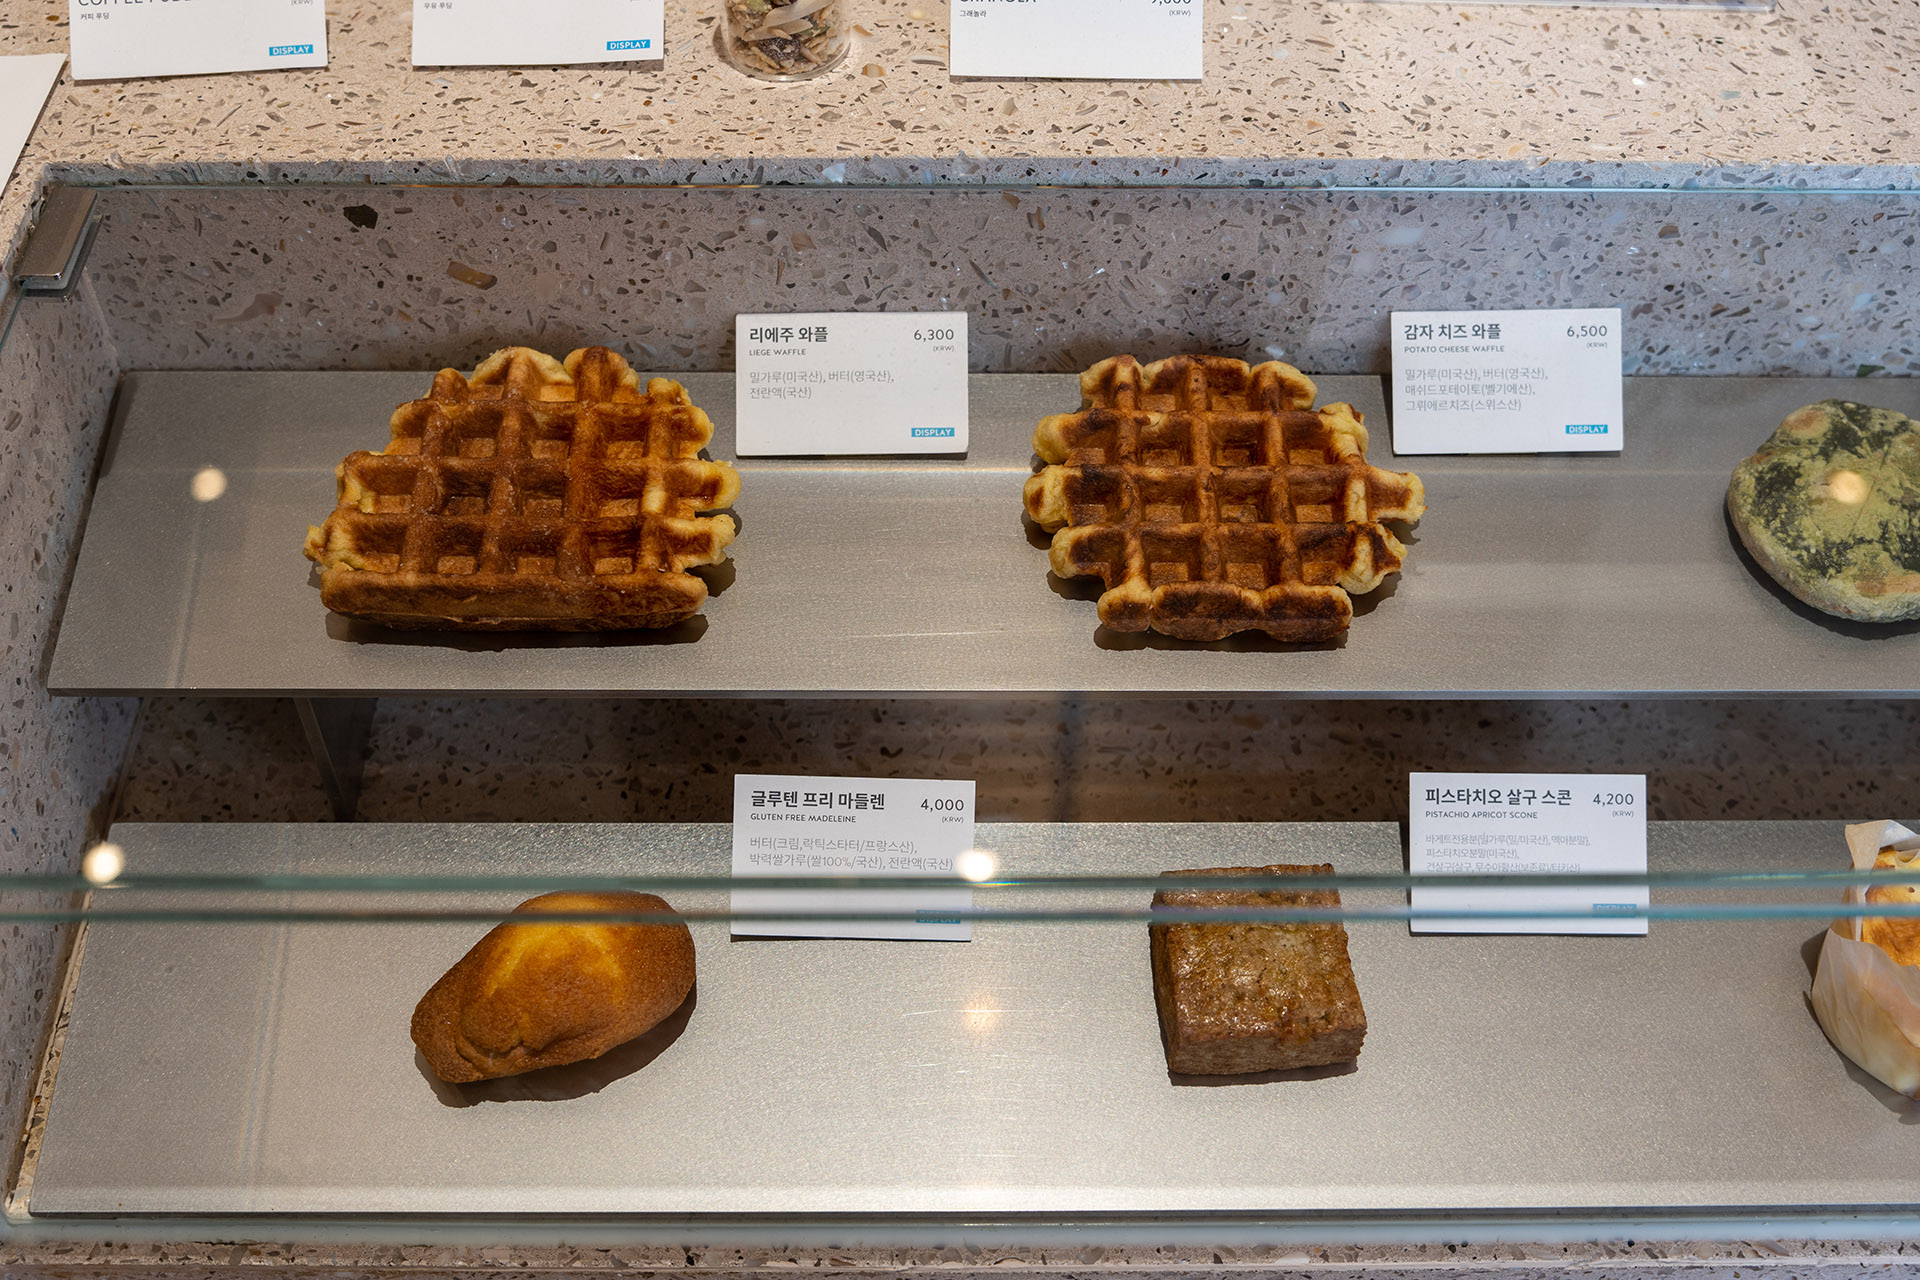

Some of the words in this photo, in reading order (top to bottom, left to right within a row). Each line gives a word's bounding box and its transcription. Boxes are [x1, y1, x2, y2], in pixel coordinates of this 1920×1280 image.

[272, 46, 310, 55] DISPLAY
[610, 41, 647, 50] DISPLAY
[750, 327, 794, 343] 리에주
[798, 326, 828, 342] 와플
[914, 328, 954, 342] 6,300
[1404, 324, 1434, 340] 감자
[1438, 324, 1468, 340] 치즈
[1471, 323, 1501, 340] 와플
[1566, 325, 1608, 338] 6,500
[749, 348, 771, 356] LIEGE
[750, 370, 826, 384] 밀가루(미국산),
[828, 370, 894, 384] 버터(영국산),
[1405, 368, 1480, 382] 밀가루(미국산),
[1482, 367, 1548, 380] 버터(영국산),
[750, 386, 812, 400] 전란액(국산)
[914, 428, 952, 436] DISPLAY
[1568, 426, 1605, 434] DISPLAY
[751, 790, 798, 808] 글루텐
[802, 792, 833, 809] 프리
[838, 792, 885, 810] 마들렌
[1426, 788, 1502, 805] 피스타치오
[1506, 788, 1538, 806] 살구
[1541, 790, 1572, 806] 스콘
[1592, 793, 1634, 807] 4,200
[920, 798, 964, 812] 4,000
[750, 812, 783, 821] GLUTEN
[785, 814, 806, 822] FREE
[808, 814, 857, 823] MADELEINE
[1426, 810, 1470, 818] PISTACHIO
[750, 837, 917, 854] 버터(크림,락틱스타터/프랑스산),
[750, 854, 886, 870] 박력쌀가루(쌀100%/국산),
[888, 856, 954, 870] 전란액(국산)
